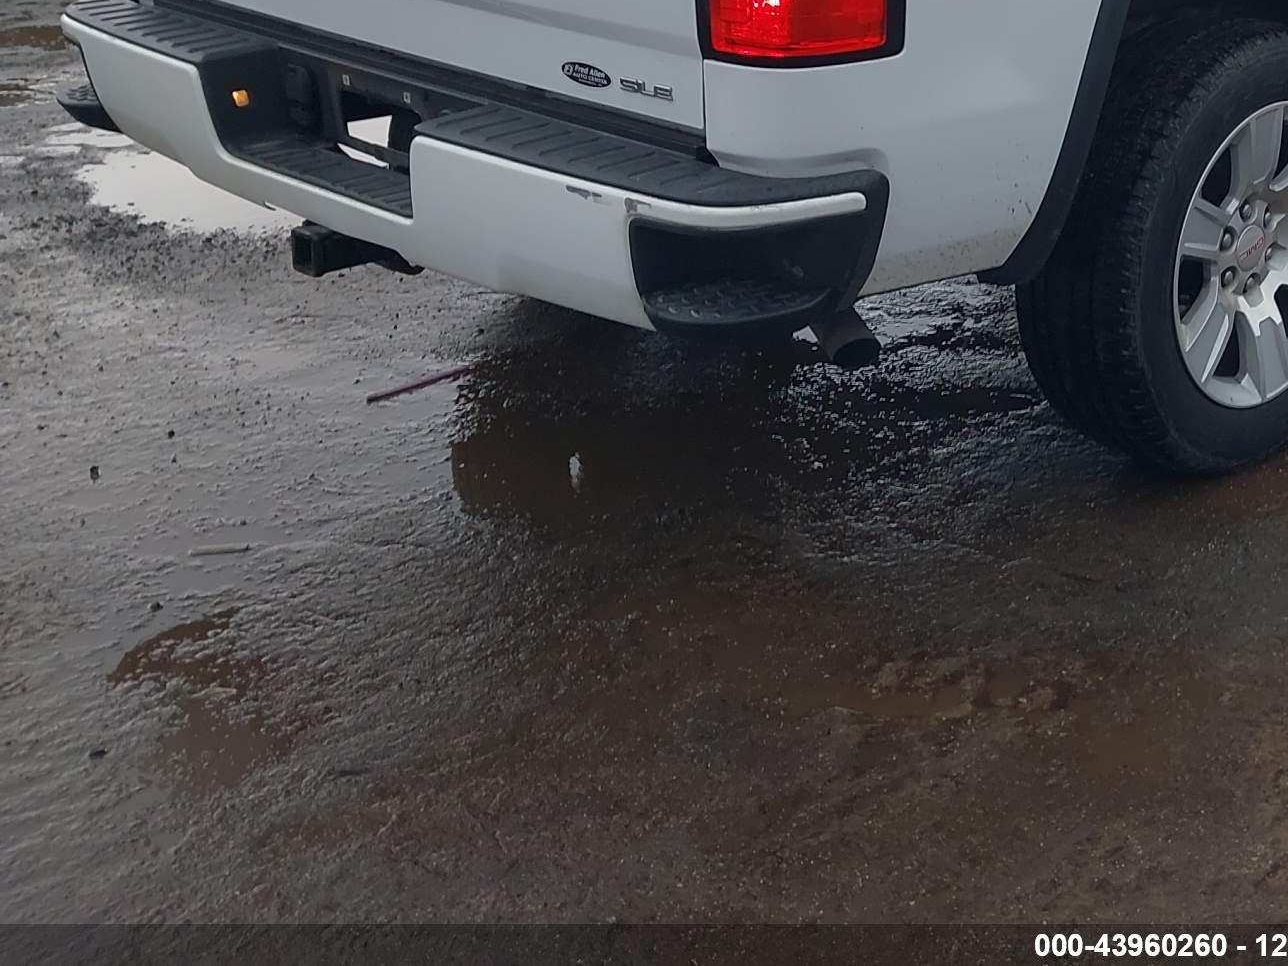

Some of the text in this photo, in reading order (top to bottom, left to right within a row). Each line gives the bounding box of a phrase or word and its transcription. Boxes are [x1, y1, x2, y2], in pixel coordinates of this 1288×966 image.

[574, 64, 606, 78] Fred Allen
[620, 77, 674, 101] SLE
[1239, 235, 1265, 260] GMC
